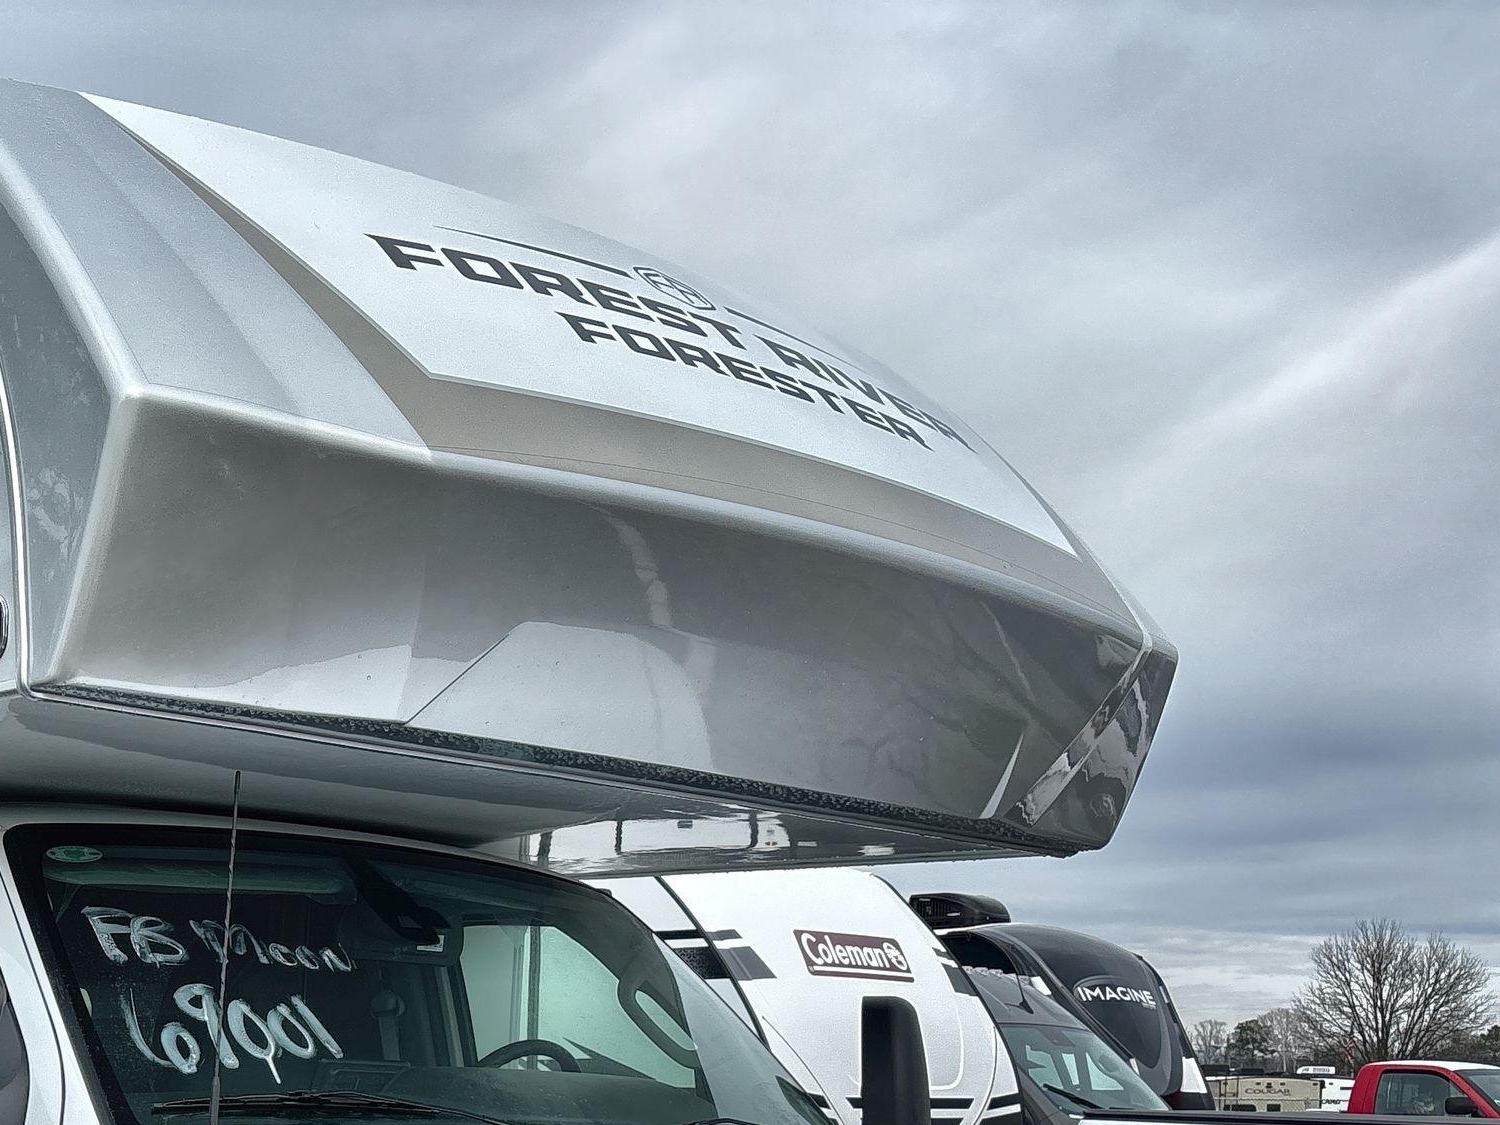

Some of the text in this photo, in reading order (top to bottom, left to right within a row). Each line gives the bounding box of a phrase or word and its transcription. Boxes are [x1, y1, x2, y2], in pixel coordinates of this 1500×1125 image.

[364, 233, 979, 454] FOREST RIVER
[554, 311, 935, 452] FORESTER
[801, 932, 891, 969] Coleman
[1077, 986, 1157, 1005] IMAGINE
